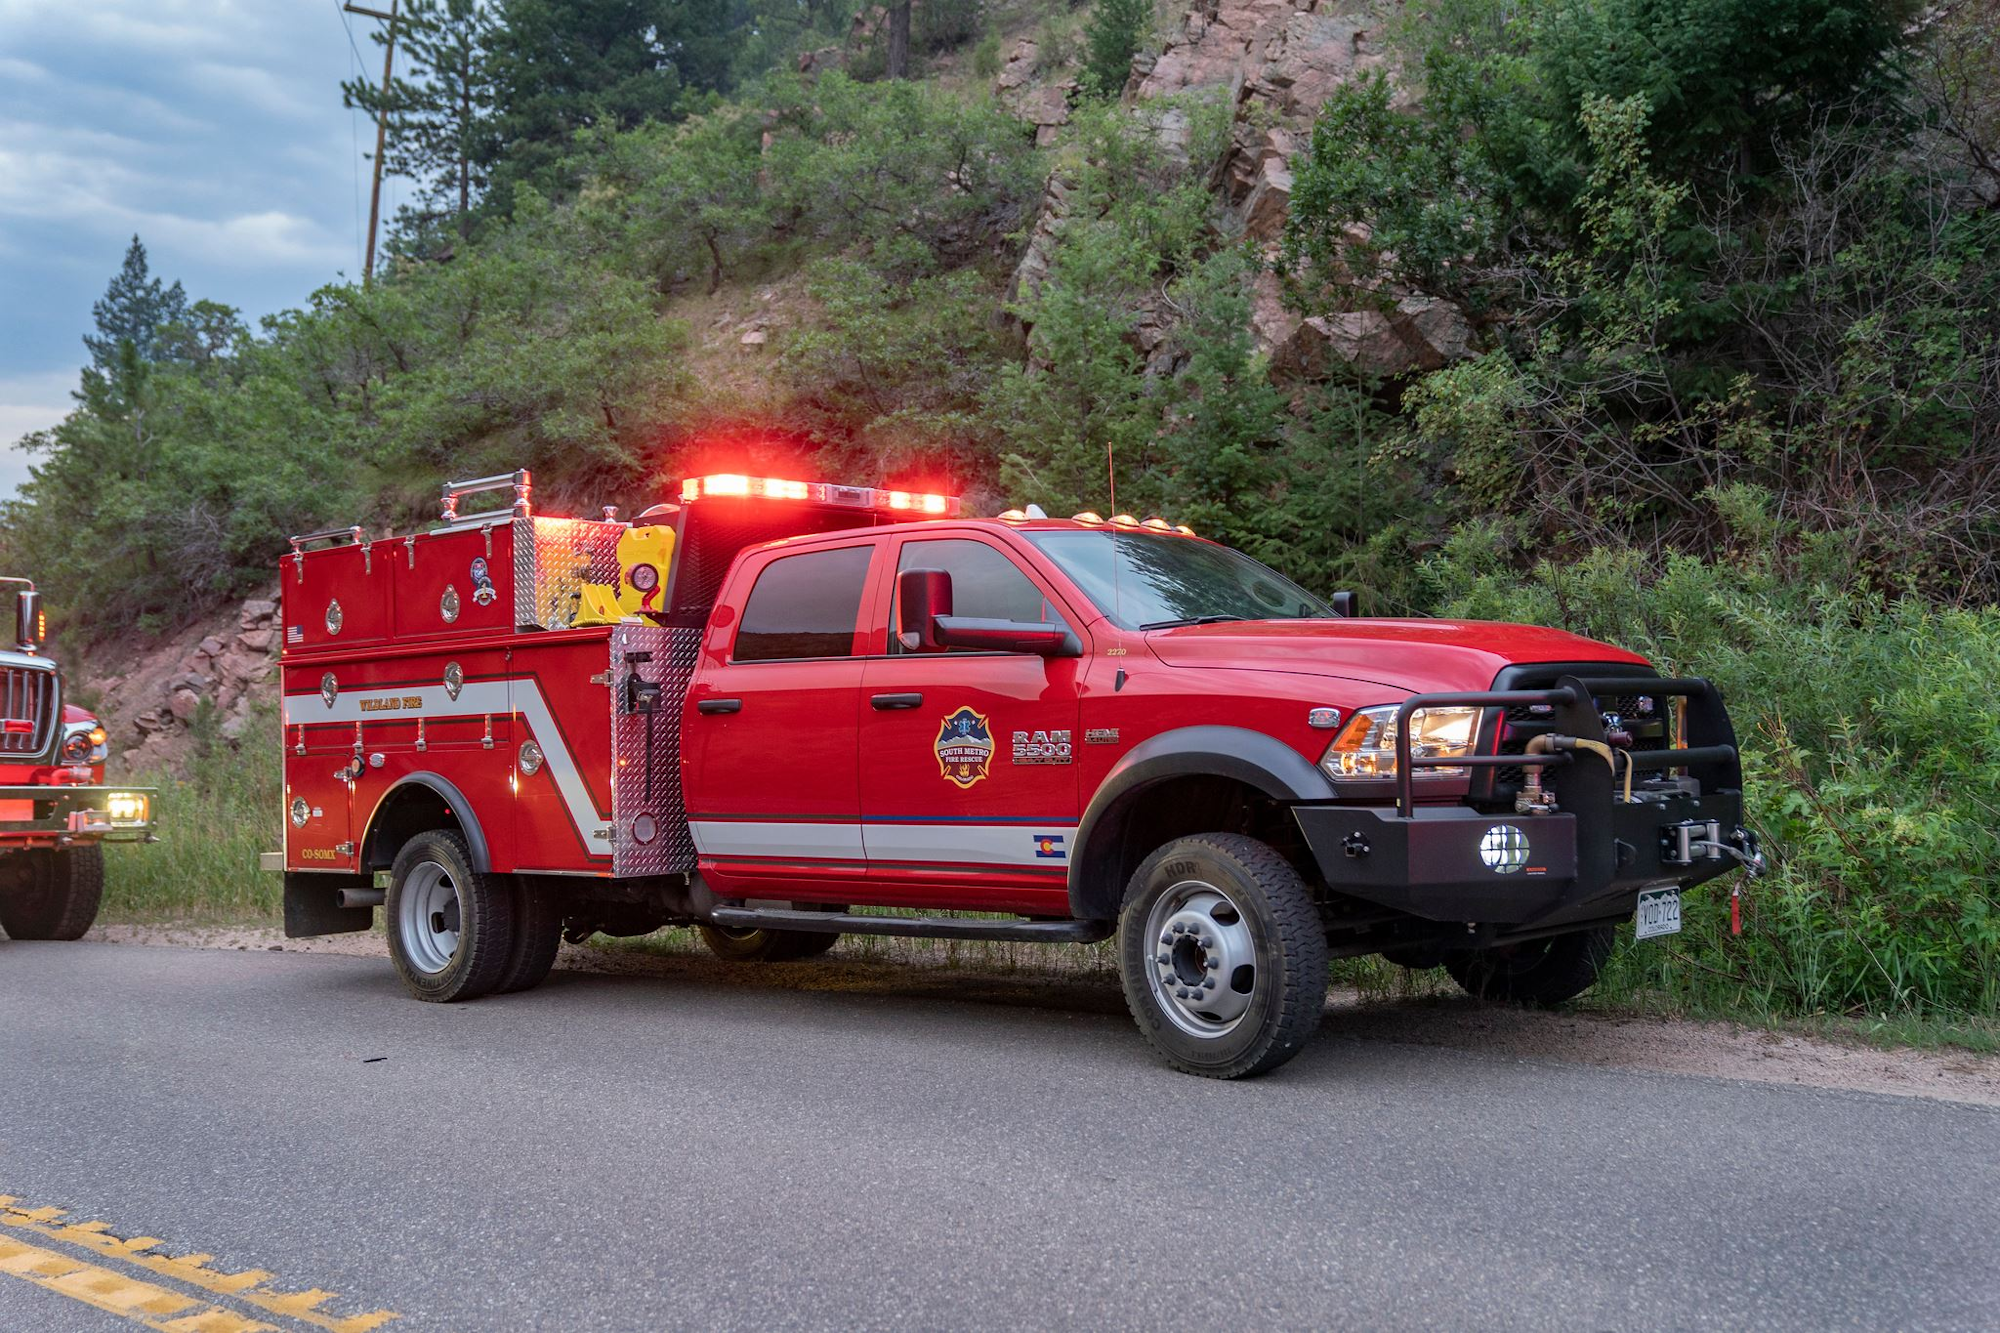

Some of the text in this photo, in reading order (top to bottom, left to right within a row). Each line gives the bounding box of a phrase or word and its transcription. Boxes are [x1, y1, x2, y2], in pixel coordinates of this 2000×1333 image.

[1107, 648, 1126, 656] 2270
[359, 695, 422, 711] WILDLAND FIRE
[1012, 729, 1071, 743] RAM
[940, 747, 989, 758] SOUTH METRO
[1012, 743, 1072, 756] 5500
[302, 848, 336, 860] CO-SOMX
